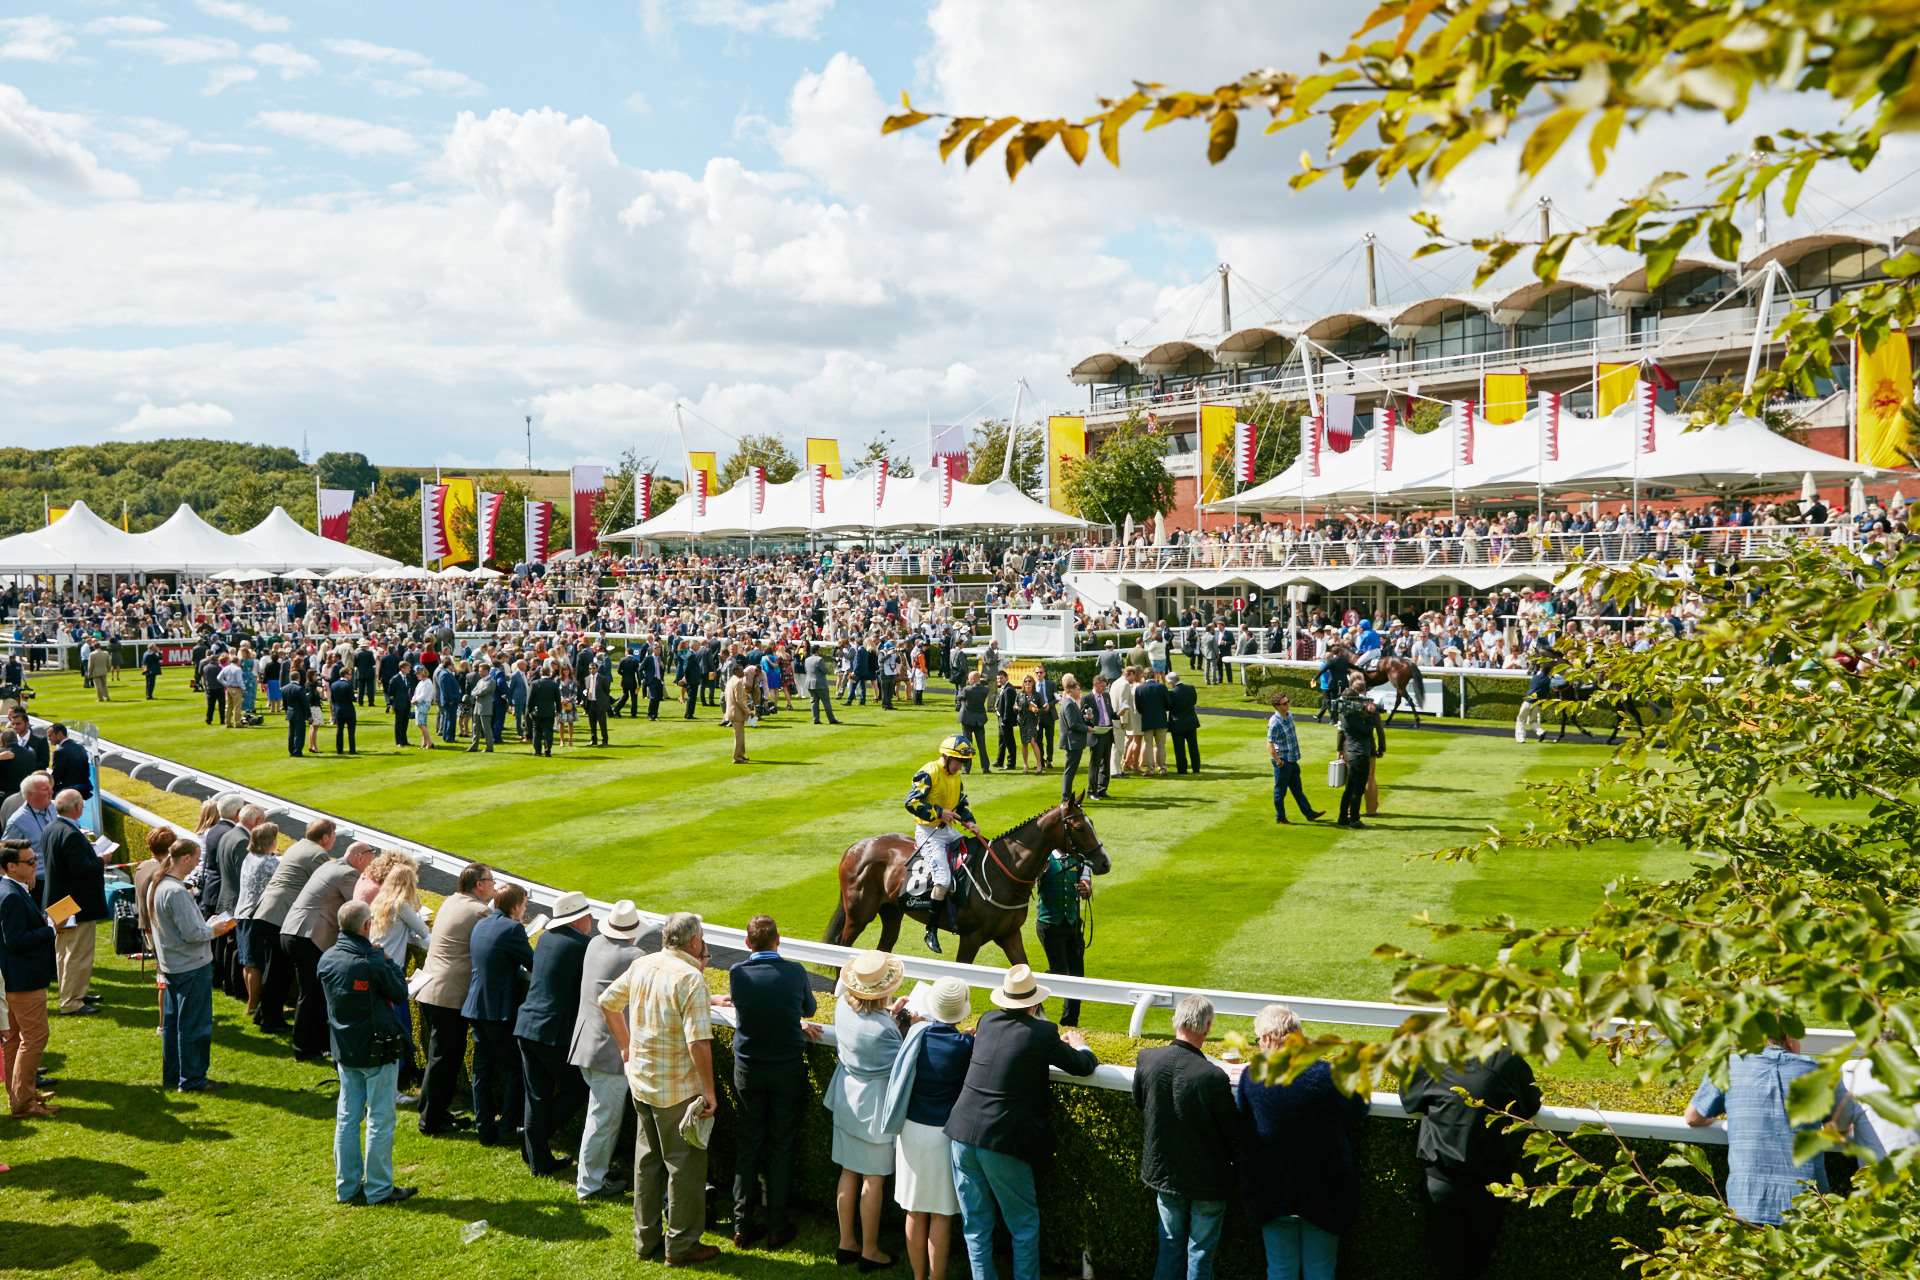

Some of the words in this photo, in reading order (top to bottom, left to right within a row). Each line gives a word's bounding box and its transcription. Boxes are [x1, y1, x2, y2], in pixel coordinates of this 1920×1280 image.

[1236, 598, 1241, 610] 1
[1450, 597, 1459, 609] 2
[1008, 616, 1015, 629] 4
[1347, 612, 1356, 626] 3
[168, 650, 193, 662] MA
[906, 859, 932, 896] 8
